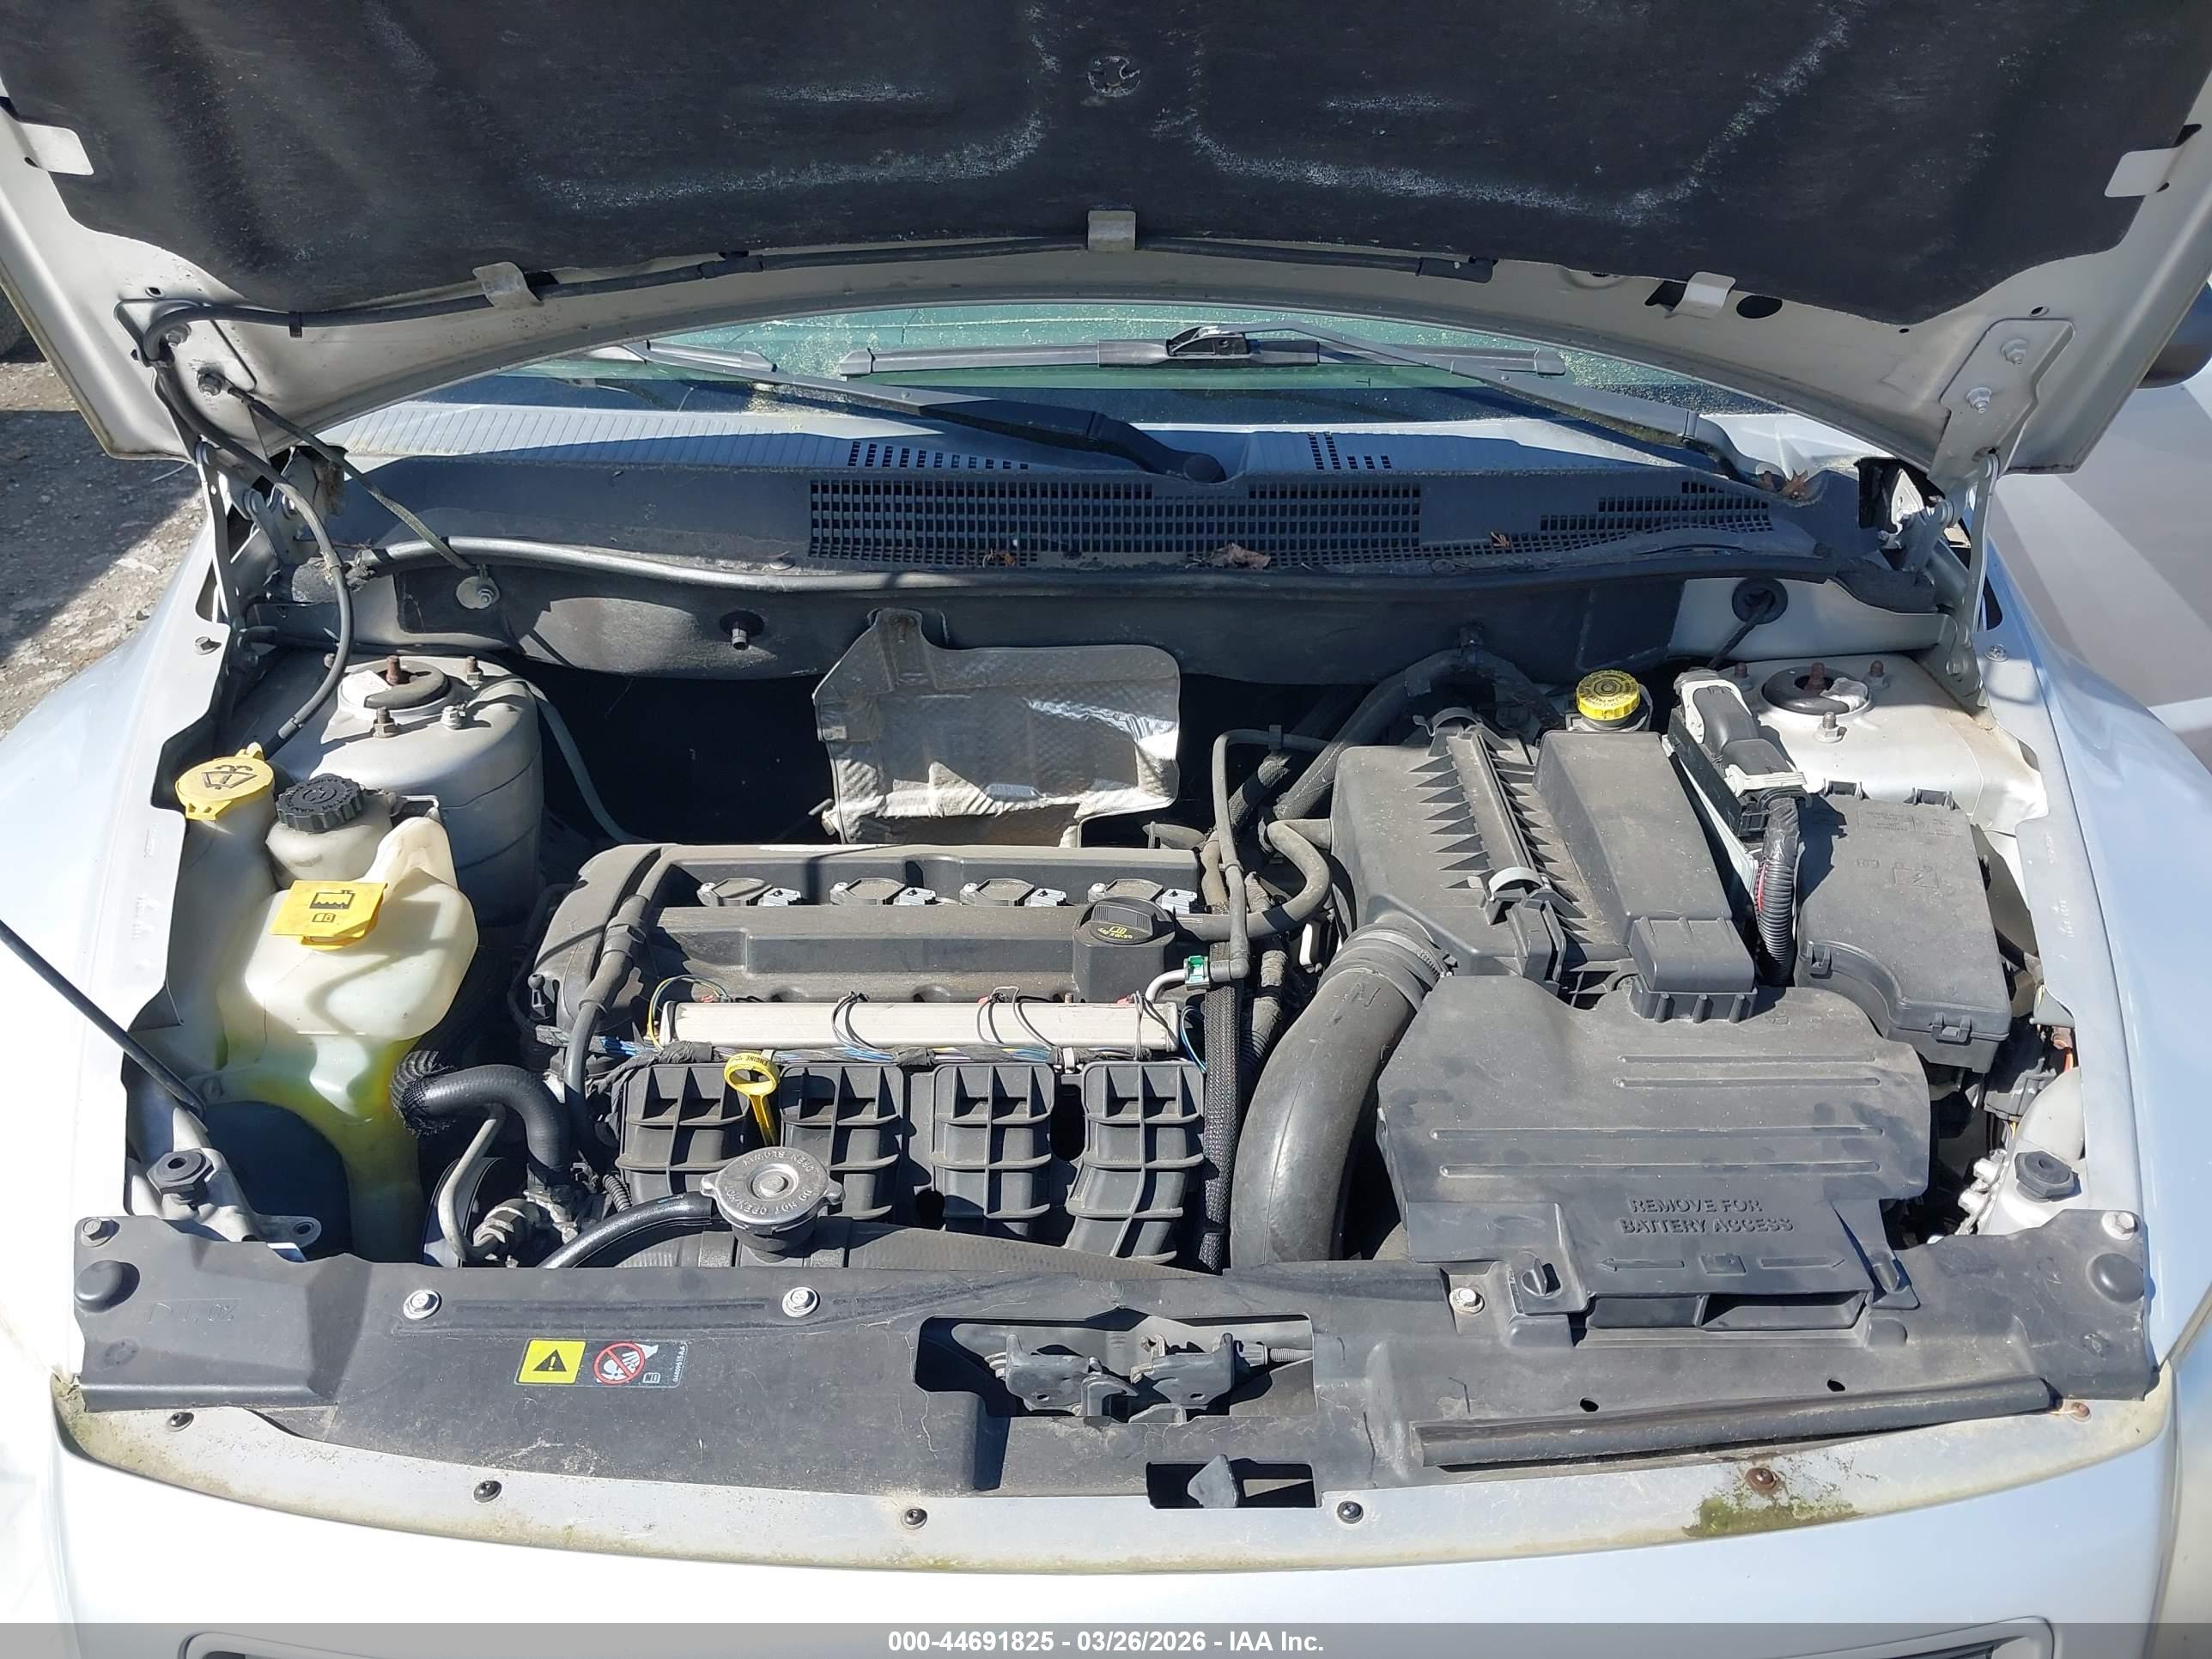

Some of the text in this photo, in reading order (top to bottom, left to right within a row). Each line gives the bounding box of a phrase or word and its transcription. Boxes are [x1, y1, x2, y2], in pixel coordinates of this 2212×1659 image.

[789, 1153, 815, 1173] OPEN
[798, 1188, 813, 1202] DO
[774, 1200, 798, 1215] NOT
[1629, 1199, 1762, 1212] REMOVE FOR
[1620, 1218, 1793, 1233] BATTERY ACCESS
